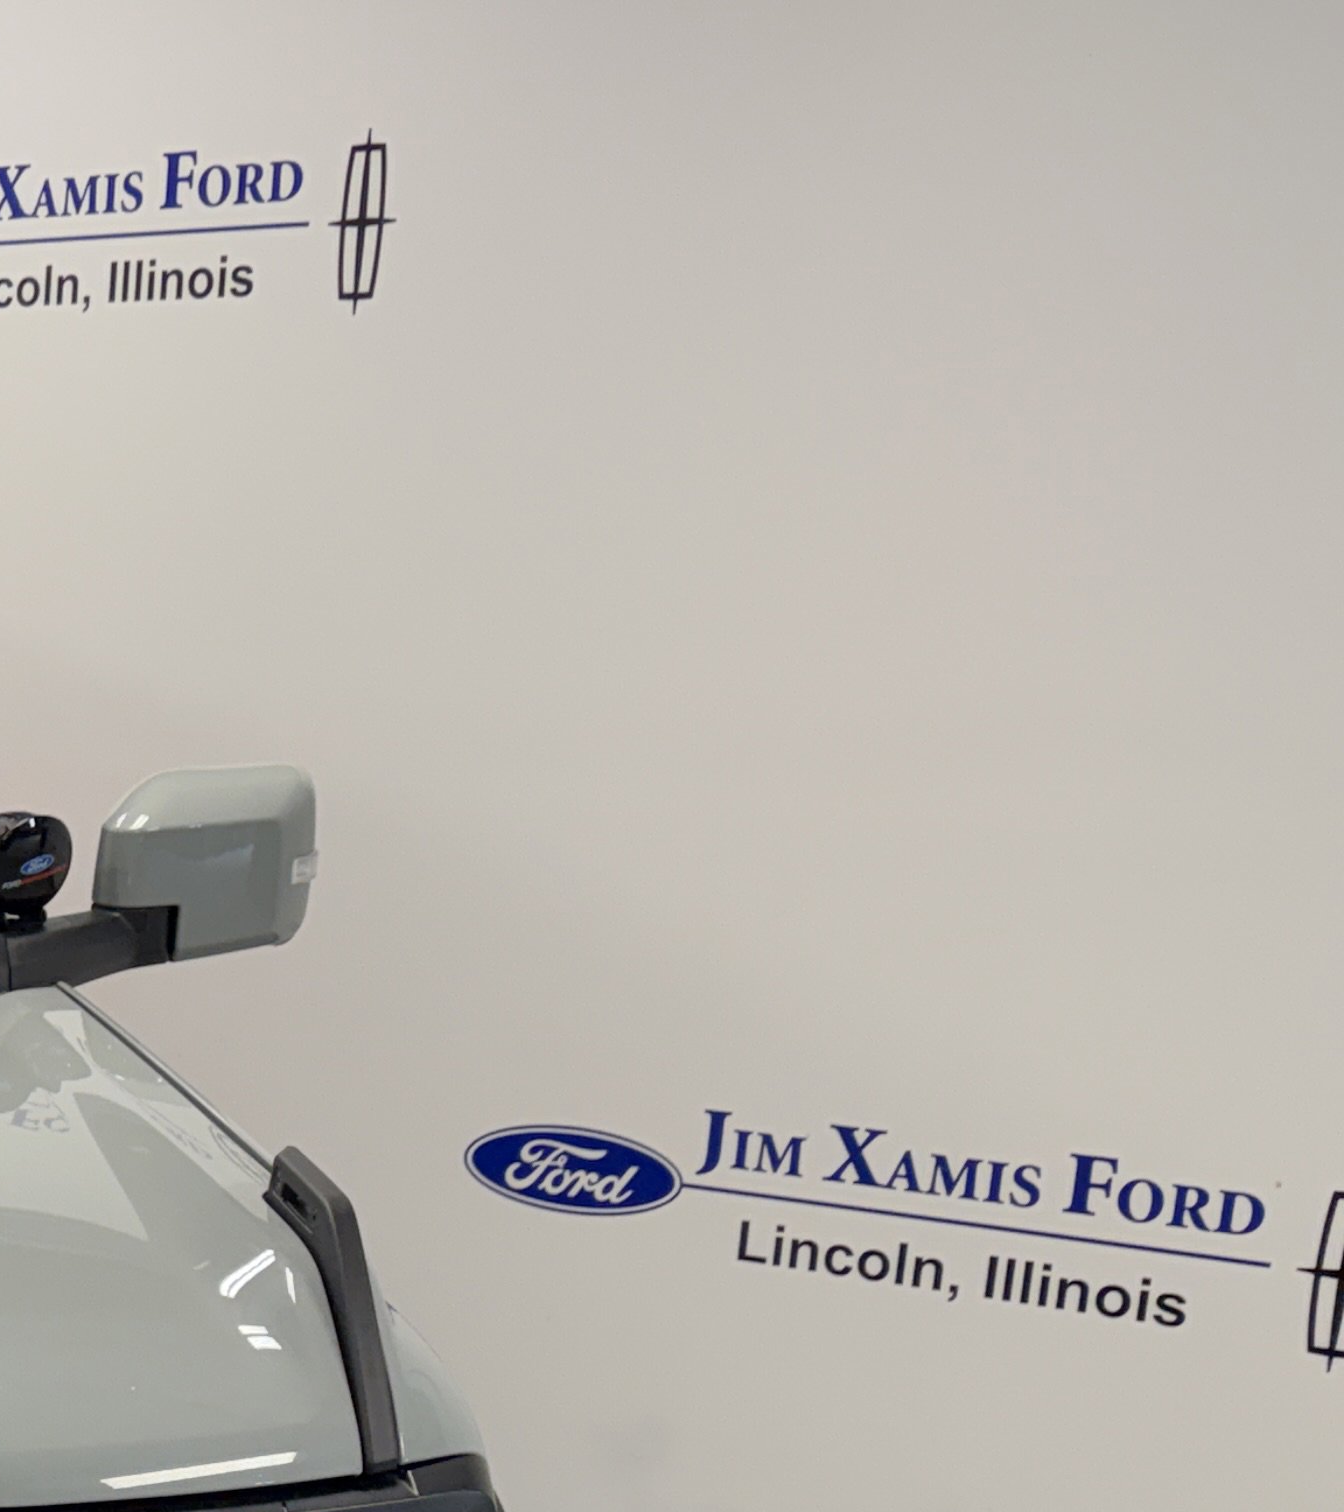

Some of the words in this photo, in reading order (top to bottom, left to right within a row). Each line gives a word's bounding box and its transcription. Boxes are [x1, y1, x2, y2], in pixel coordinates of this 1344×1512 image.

[160, 150, 304, 210] FORD
[108, 255, 254, 303] Illinois
[504, 1138, 640, 1204] Ford
[695, 1109, 805, 1177] JIM
[823, 1124, 1042, 1209] XAMIS
[1061, 1153, 1266, 1236] FORD
[737, 1220, 961, 1302] Lincoln,
[984, 1255, 1188, 1328] Illinois
